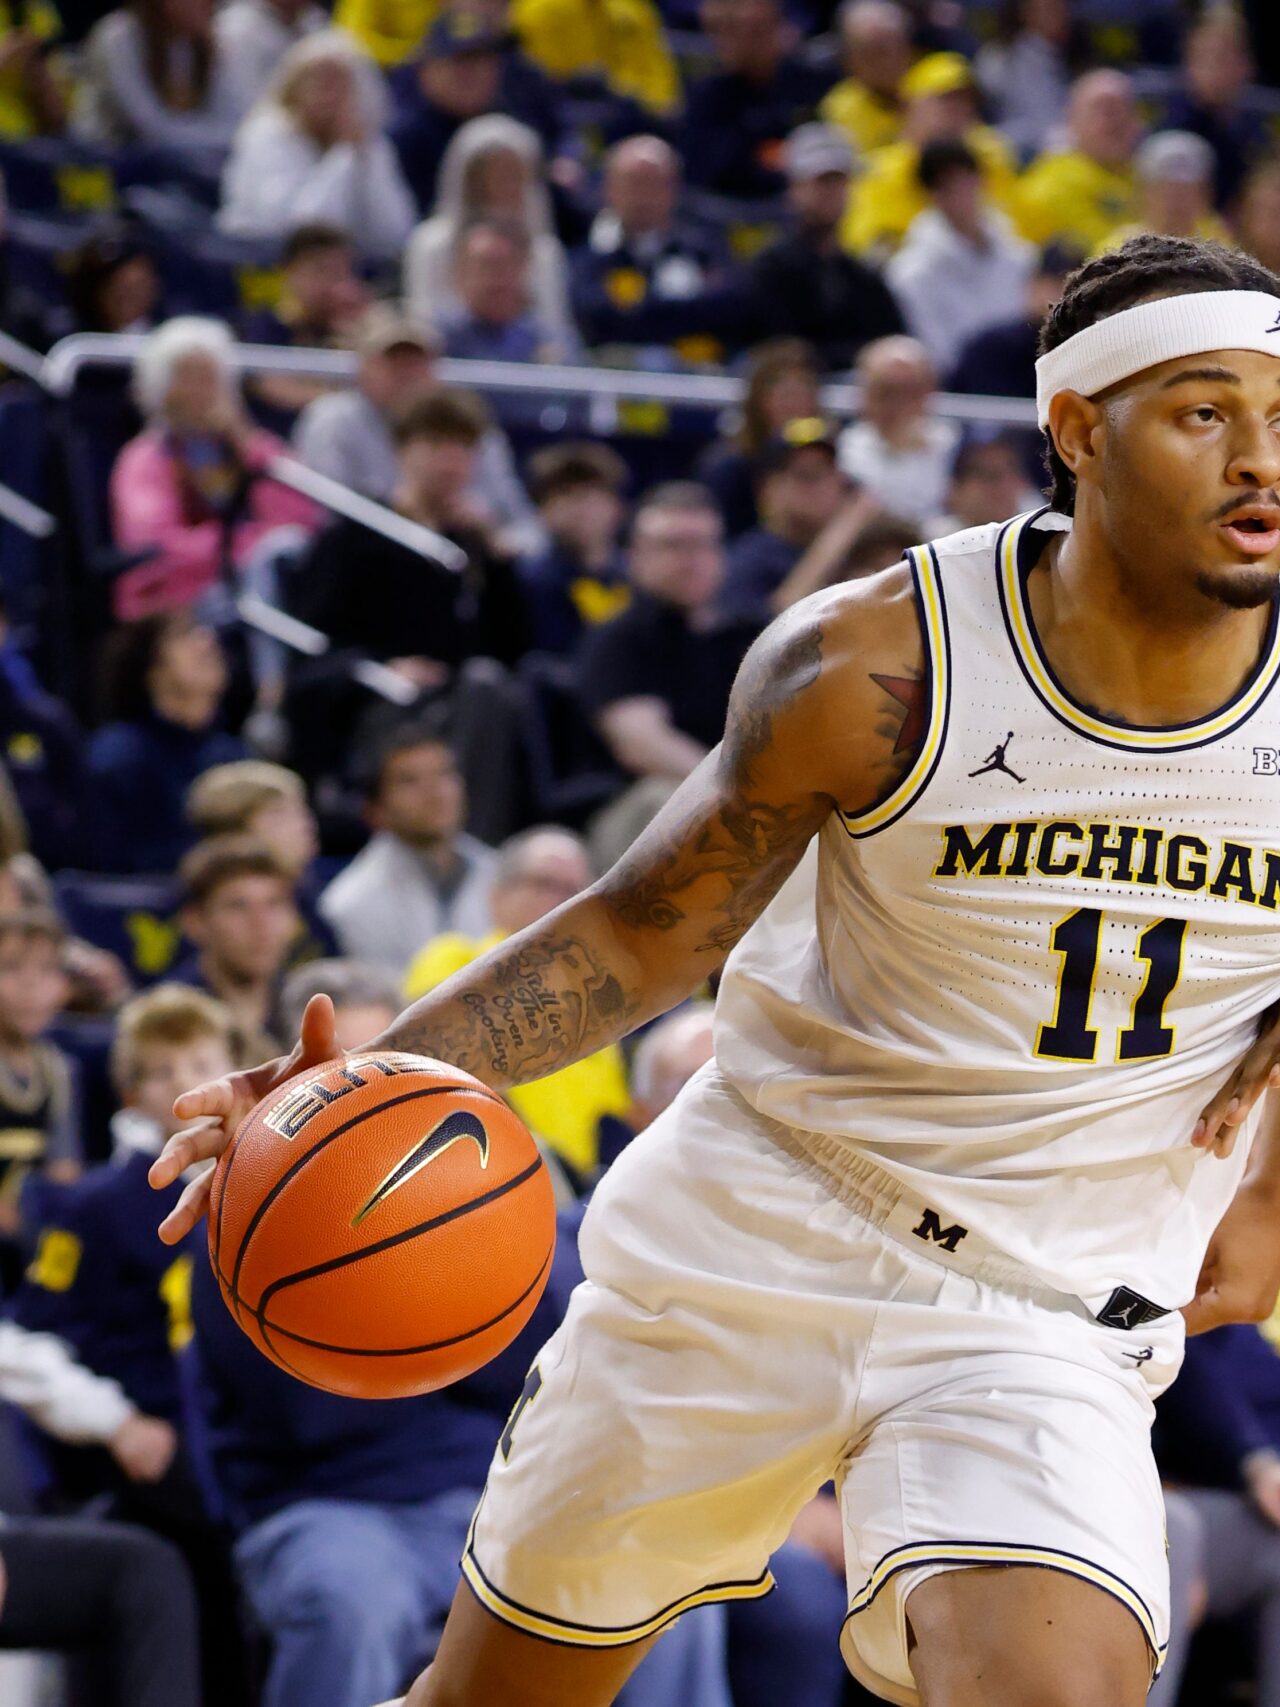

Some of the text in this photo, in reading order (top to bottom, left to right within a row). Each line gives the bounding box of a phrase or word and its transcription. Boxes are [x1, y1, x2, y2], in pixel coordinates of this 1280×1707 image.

[513, 985, 544, 1031] The
[1032, 906, 1188, 1064] 11
[462, 991, 509, 1074] Cooking
[491, 994, 525, 1050] Oven
[911, 1207, 969, 1253] M
